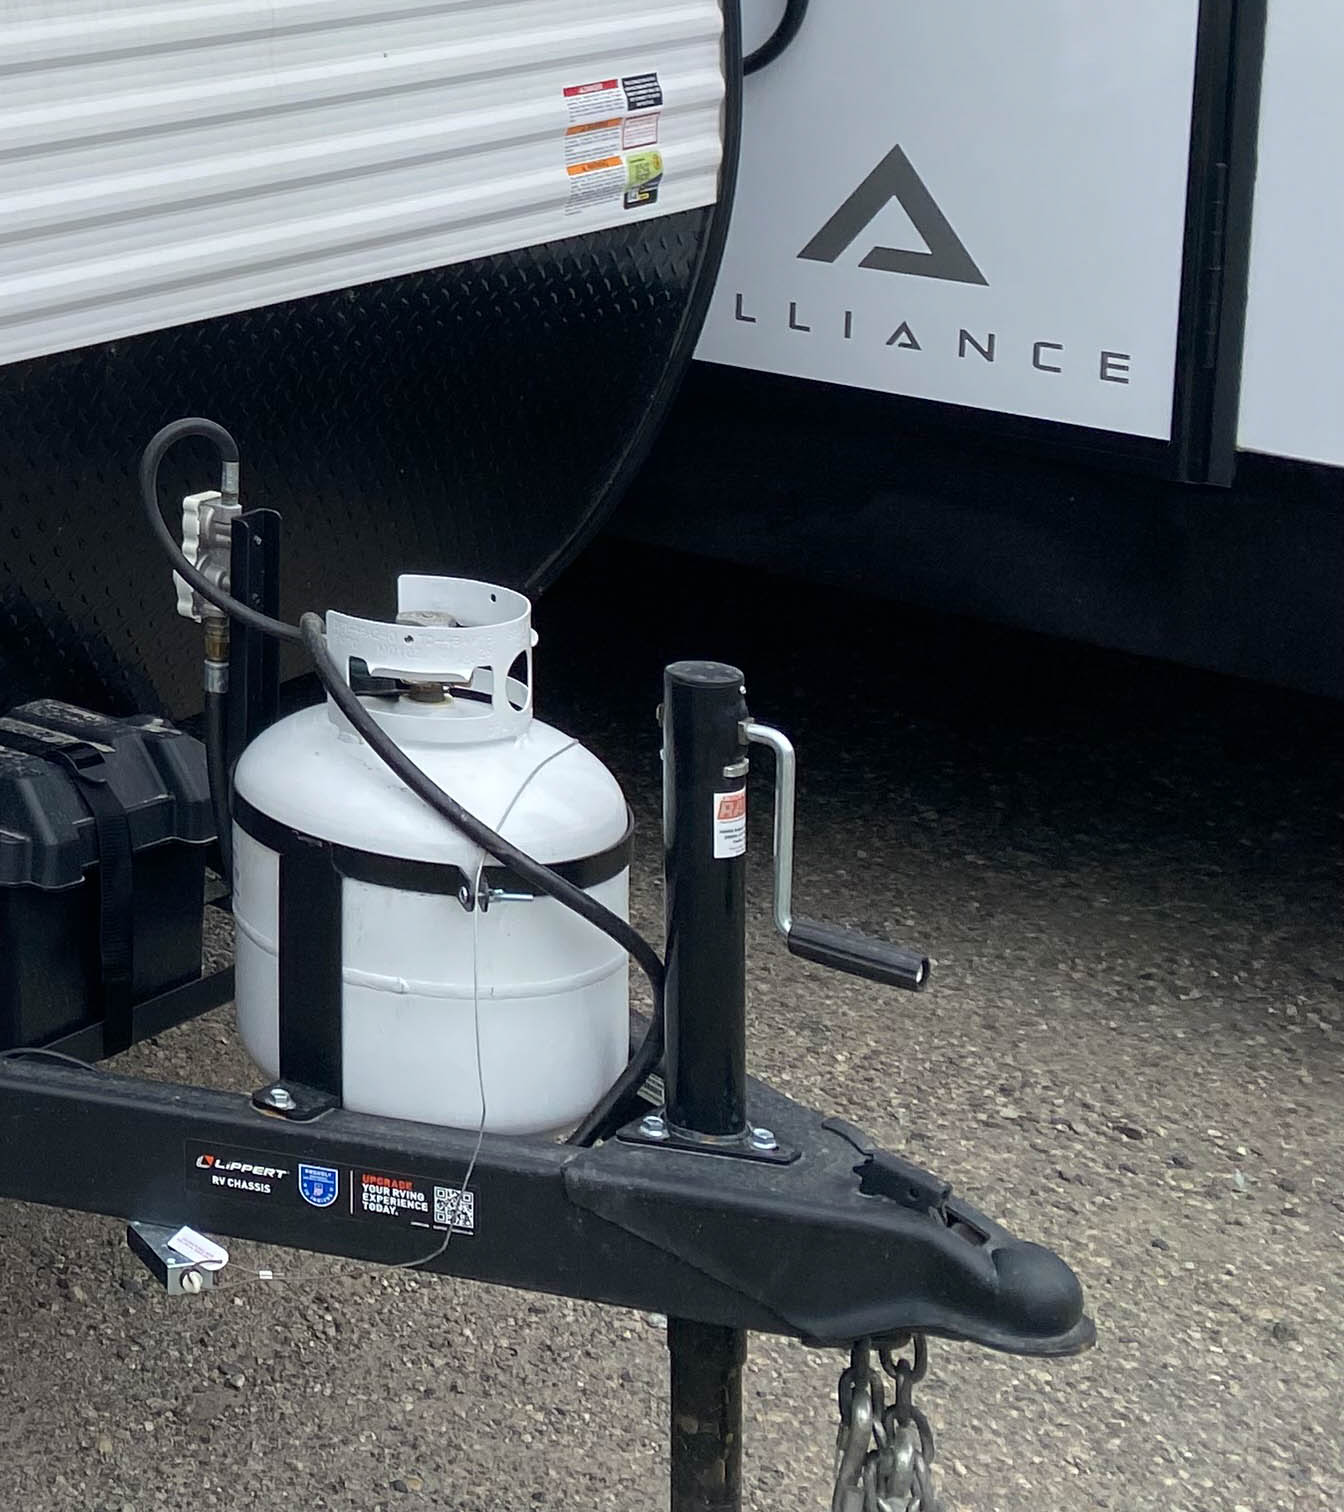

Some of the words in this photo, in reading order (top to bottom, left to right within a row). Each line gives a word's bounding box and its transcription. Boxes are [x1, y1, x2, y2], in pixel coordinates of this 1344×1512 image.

[734, 292, 1132, 384] LLIANCE
[212, 1175, 226, 1186] RV
[227, 1177, 272, 1194] CHASSIS
[362, 1174, 414, 1191] UPGRADE
[362, 1183, 391, 1197] YOUR
[392, 1188, 425, 1202] RVING
[362, 1192, 429, 1213] EXPERIENCE
[362, 1201, 399, 1216] TODAY.
